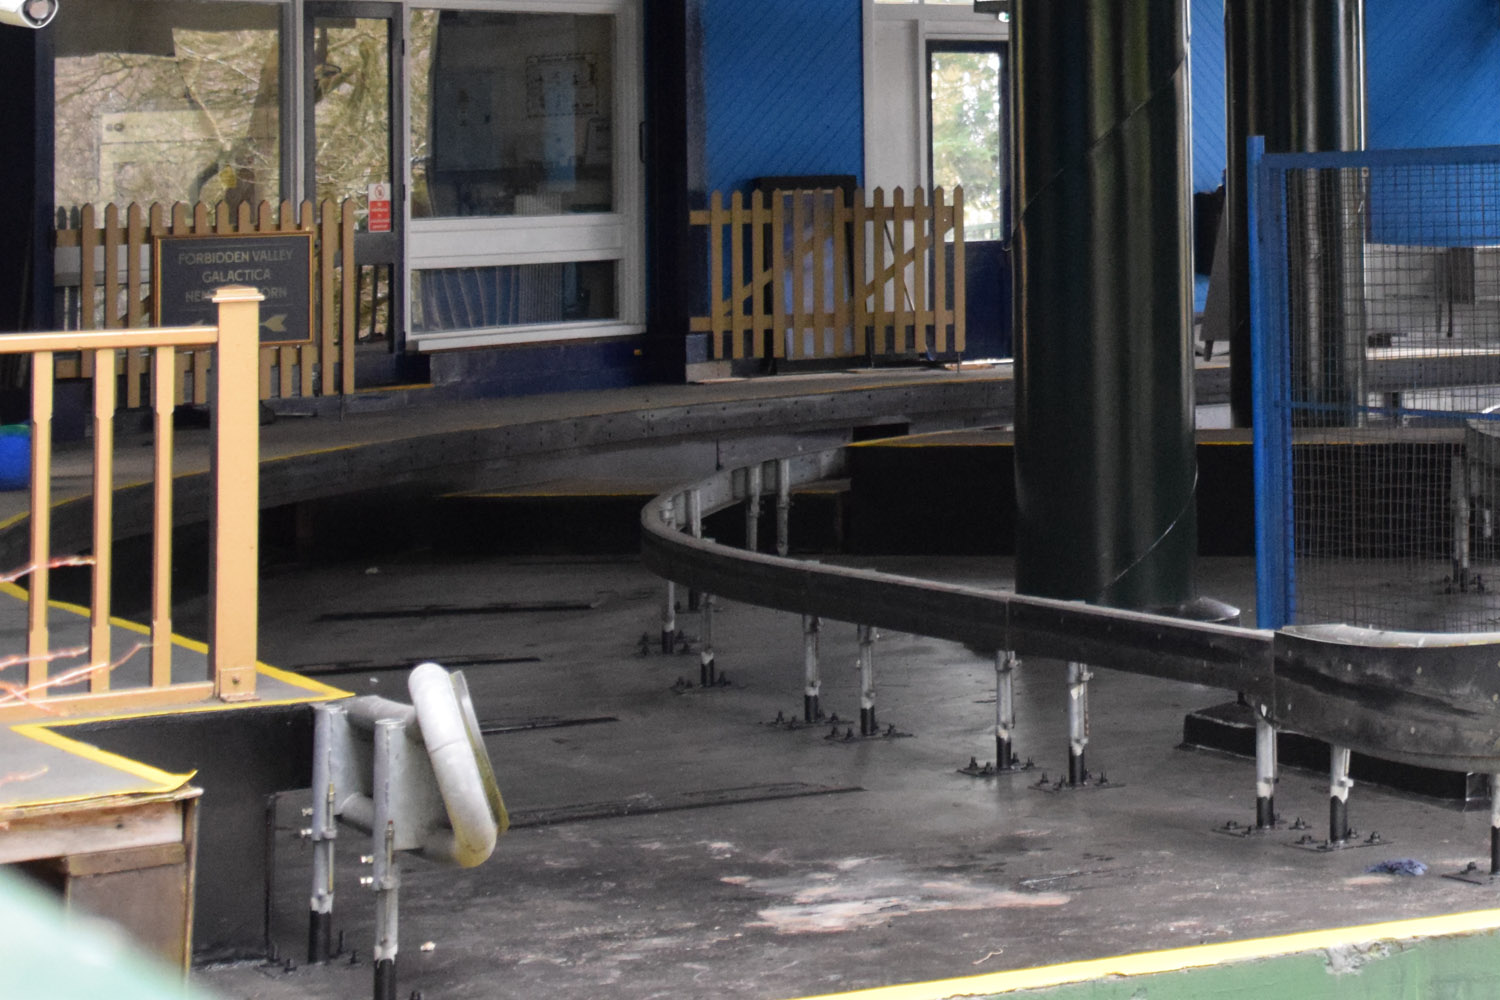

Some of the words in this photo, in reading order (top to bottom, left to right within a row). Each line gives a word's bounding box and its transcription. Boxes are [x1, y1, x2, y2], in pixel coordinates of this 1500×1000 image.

[178, 251, 249, 265] FORBIDDEN
[252, 249, 294, 262] VALLEY
[202, 268, 271, 283] GALACTICA
